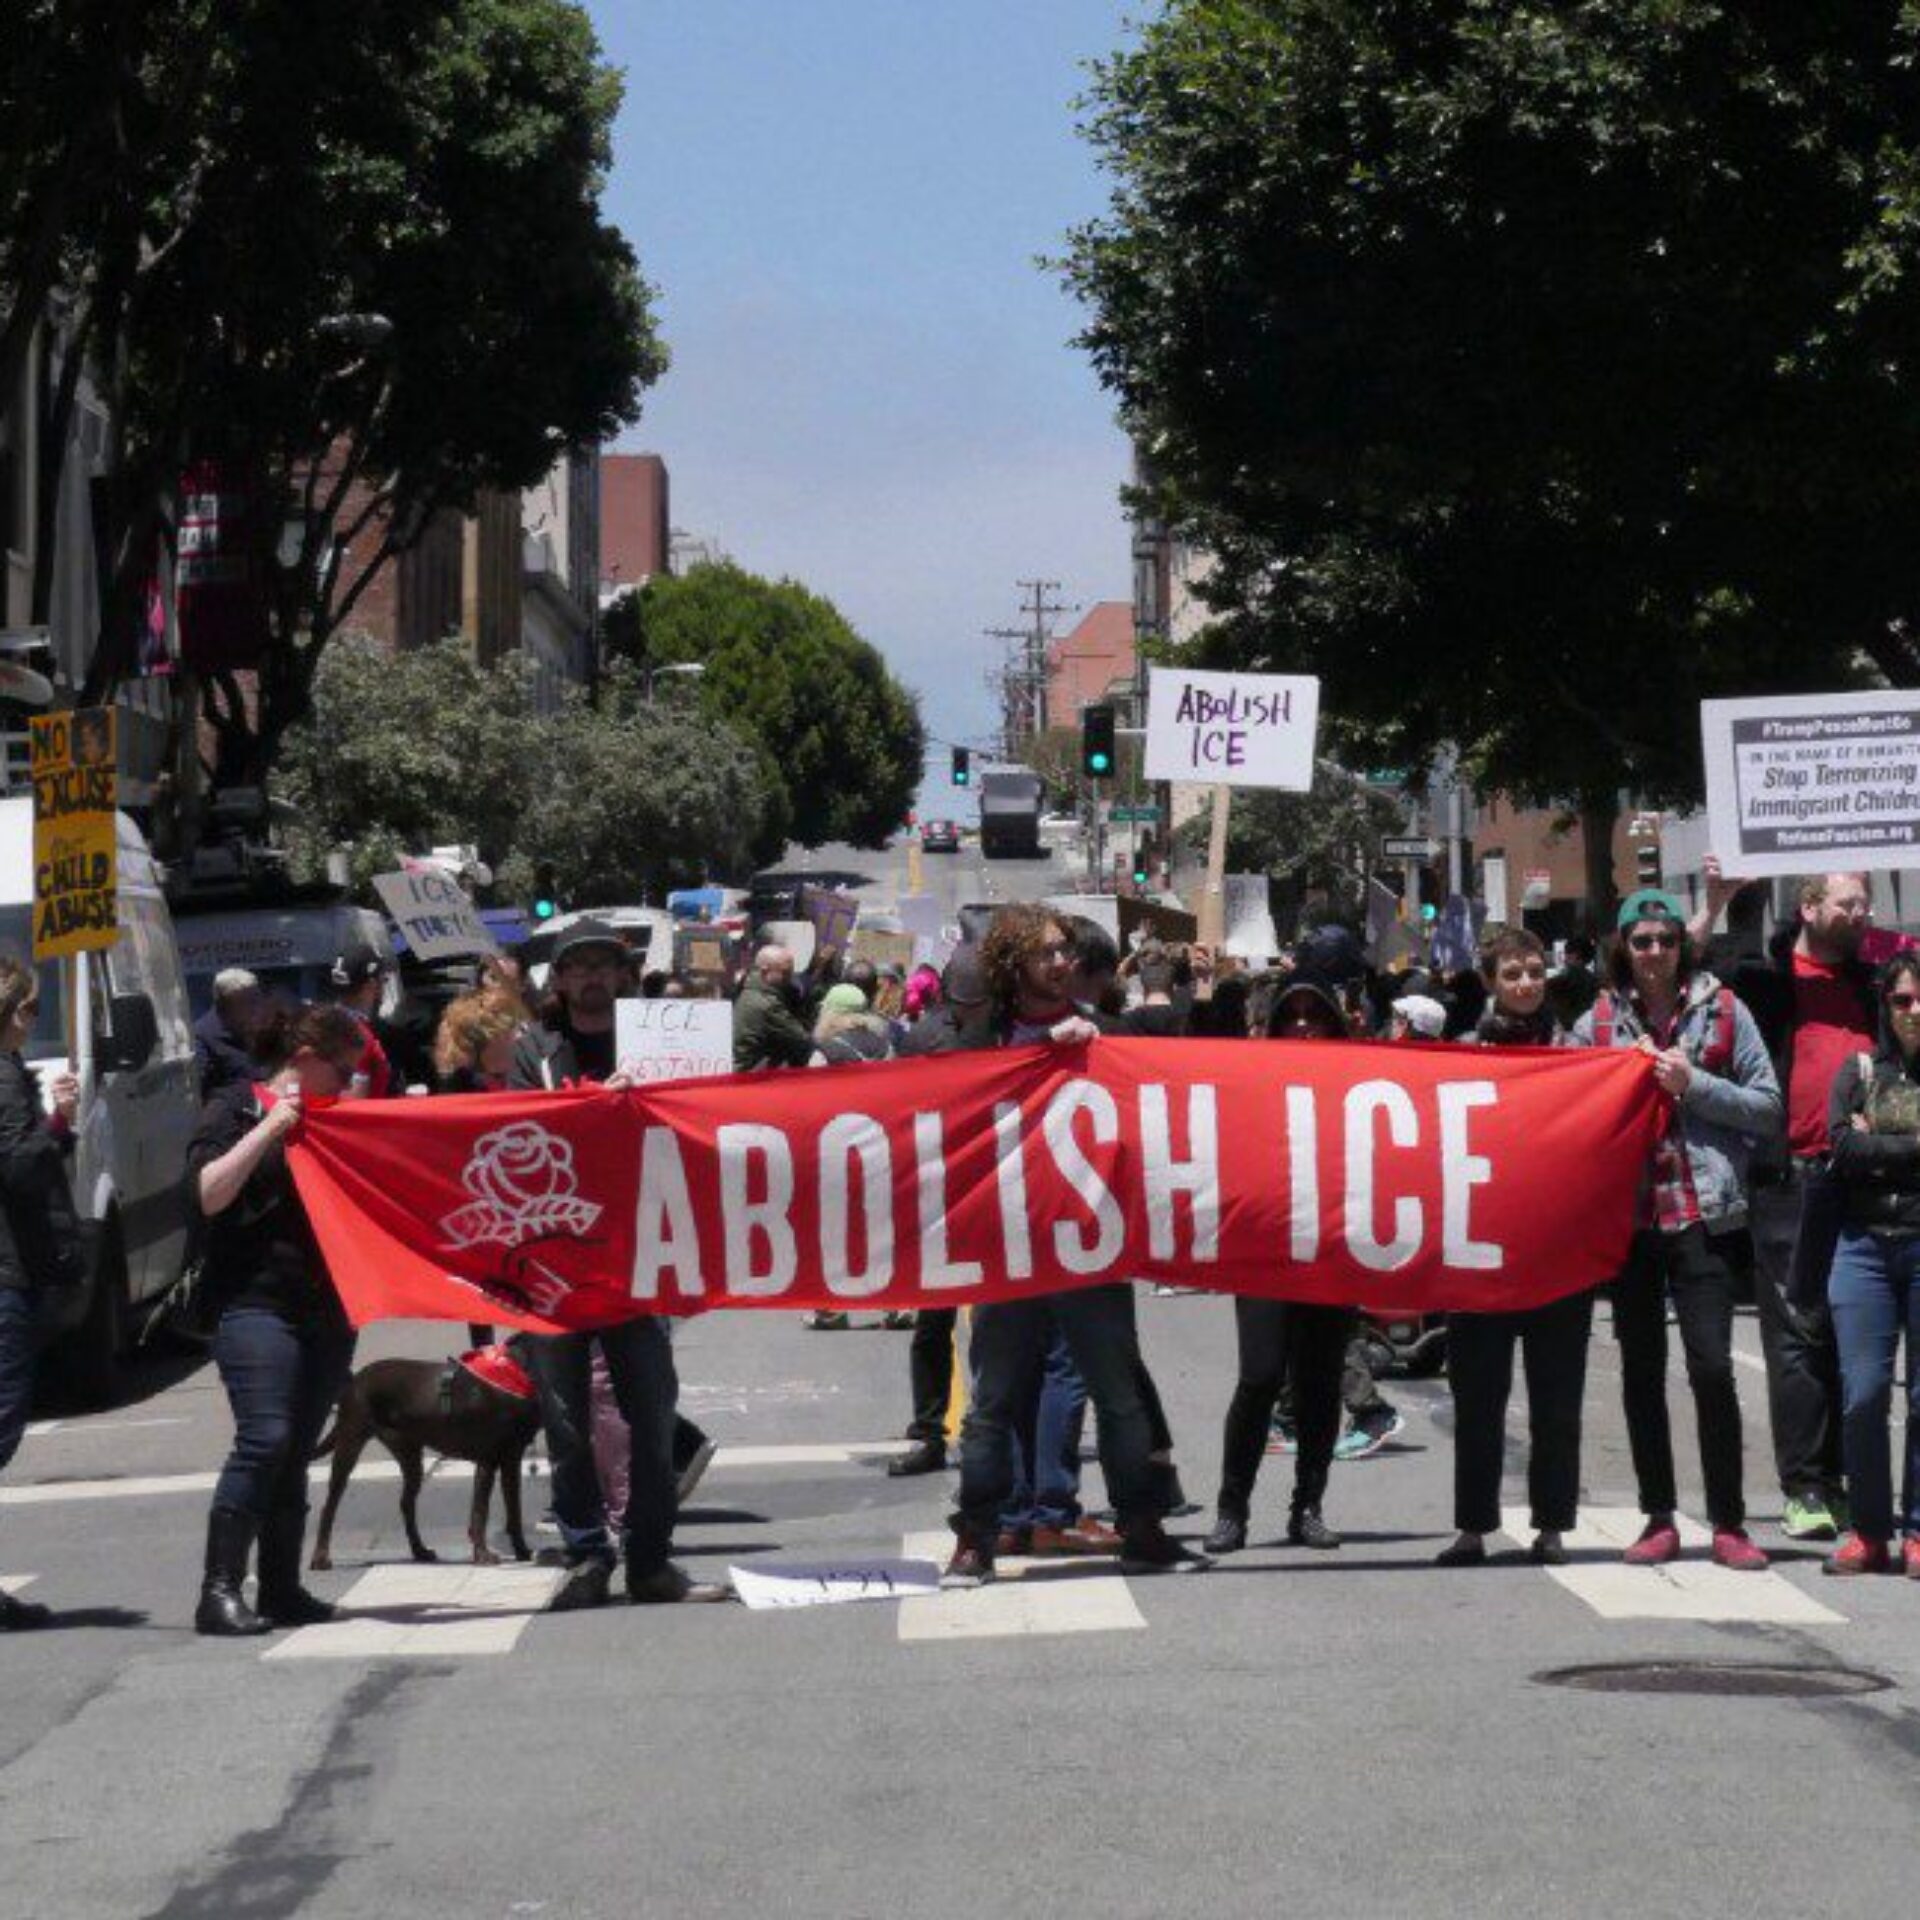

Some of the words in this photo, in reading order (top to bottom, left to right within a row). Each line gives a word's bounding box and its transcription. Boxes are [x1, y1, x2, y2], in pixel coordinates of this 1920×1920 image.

[1176, 684, 1290, 725] ABOLISH
[32, 720, 66, 759] NO
[1192, 727, 1247, 767] ICE
[34, 766, 116, 821] EXCUSE
[1763, 766, 1808, 790] Stop
[1815, 761, 1918, 786] Terrorizing
[1750, 793, 1849, 820] Immigrant
[36, 852, 109, 899] CHILD
[38, 889, 116, 943] ABUSE
[635, 1000, 703, 1032] ICE
[630, 1078, 1220, 1298] ABOLISH
[1286, 1080, 1503, 1272] ICE
